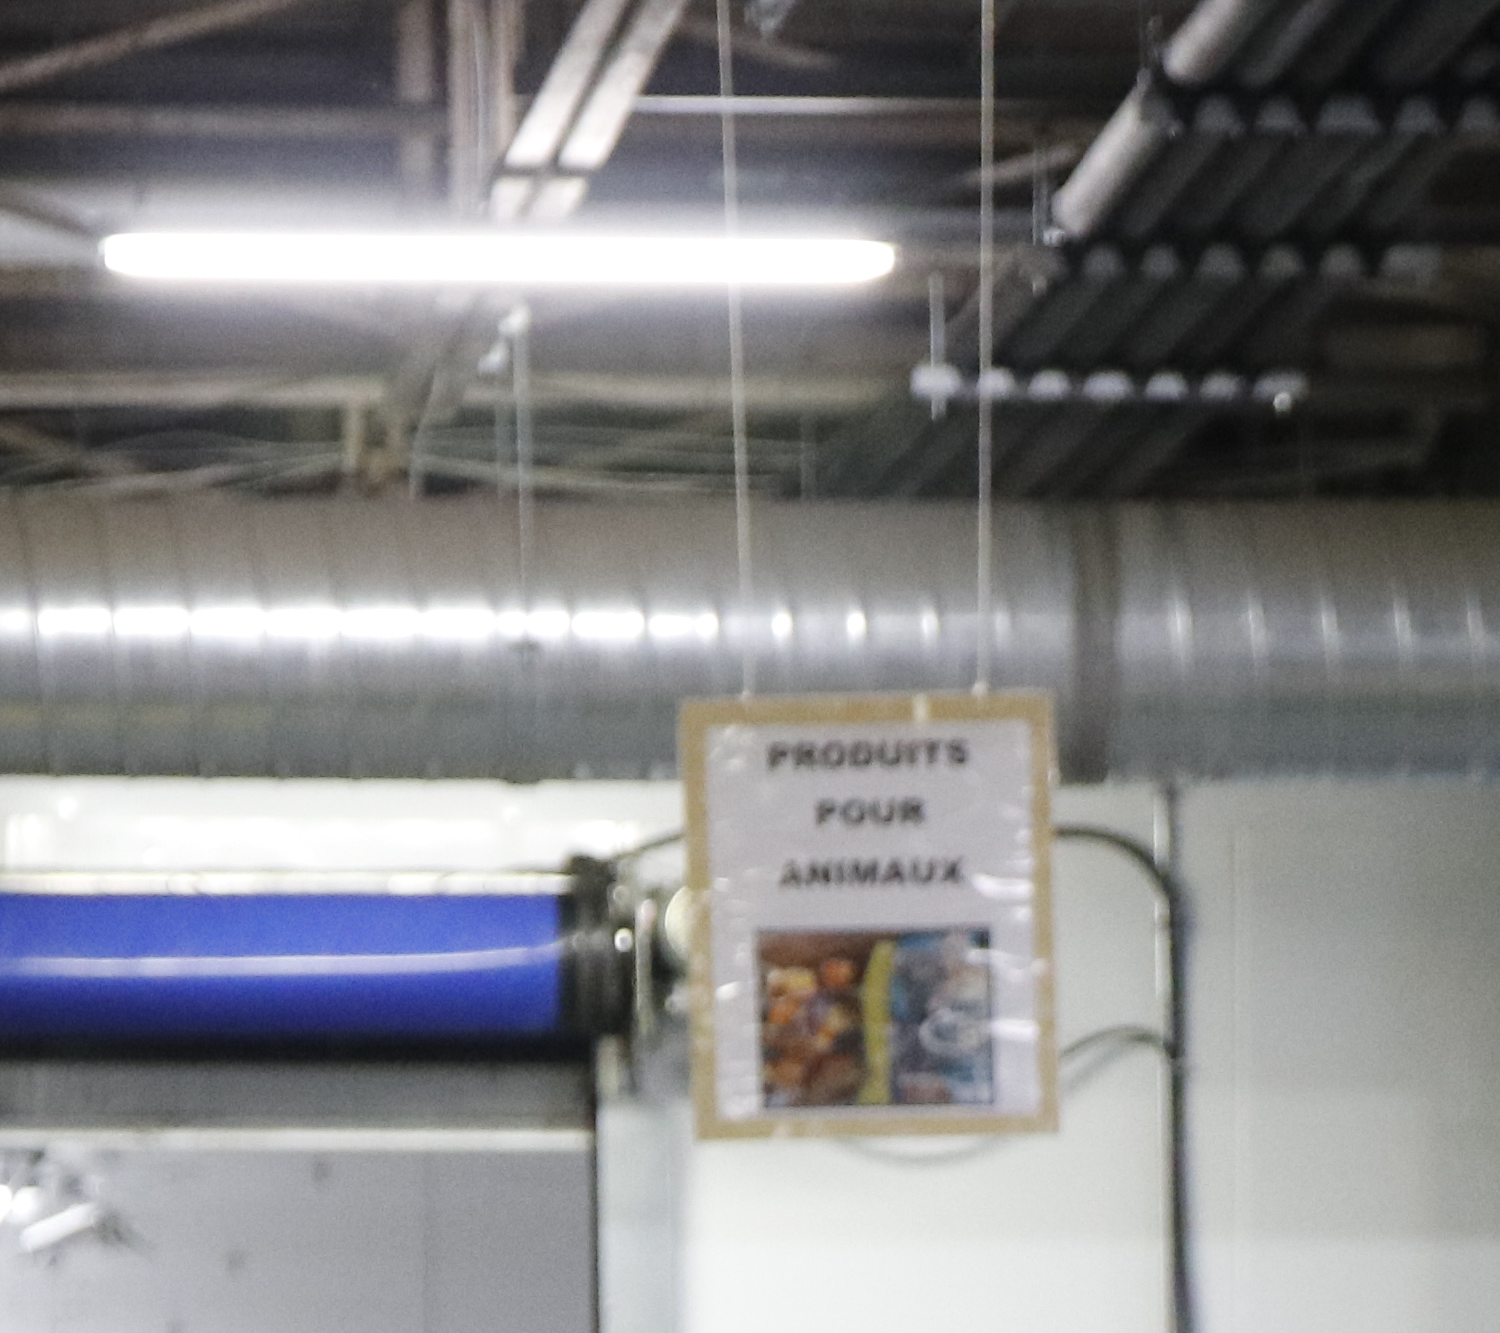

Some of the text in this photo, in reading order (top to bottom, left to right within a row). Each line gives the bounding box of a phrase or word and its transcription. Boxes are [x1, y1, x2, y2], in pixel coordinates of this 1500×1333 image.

[766, 738, 970, 770] PRODUITS
[815, 797, 926, 827] POUR
[779, 857, 964, 888] ANIMAUX
